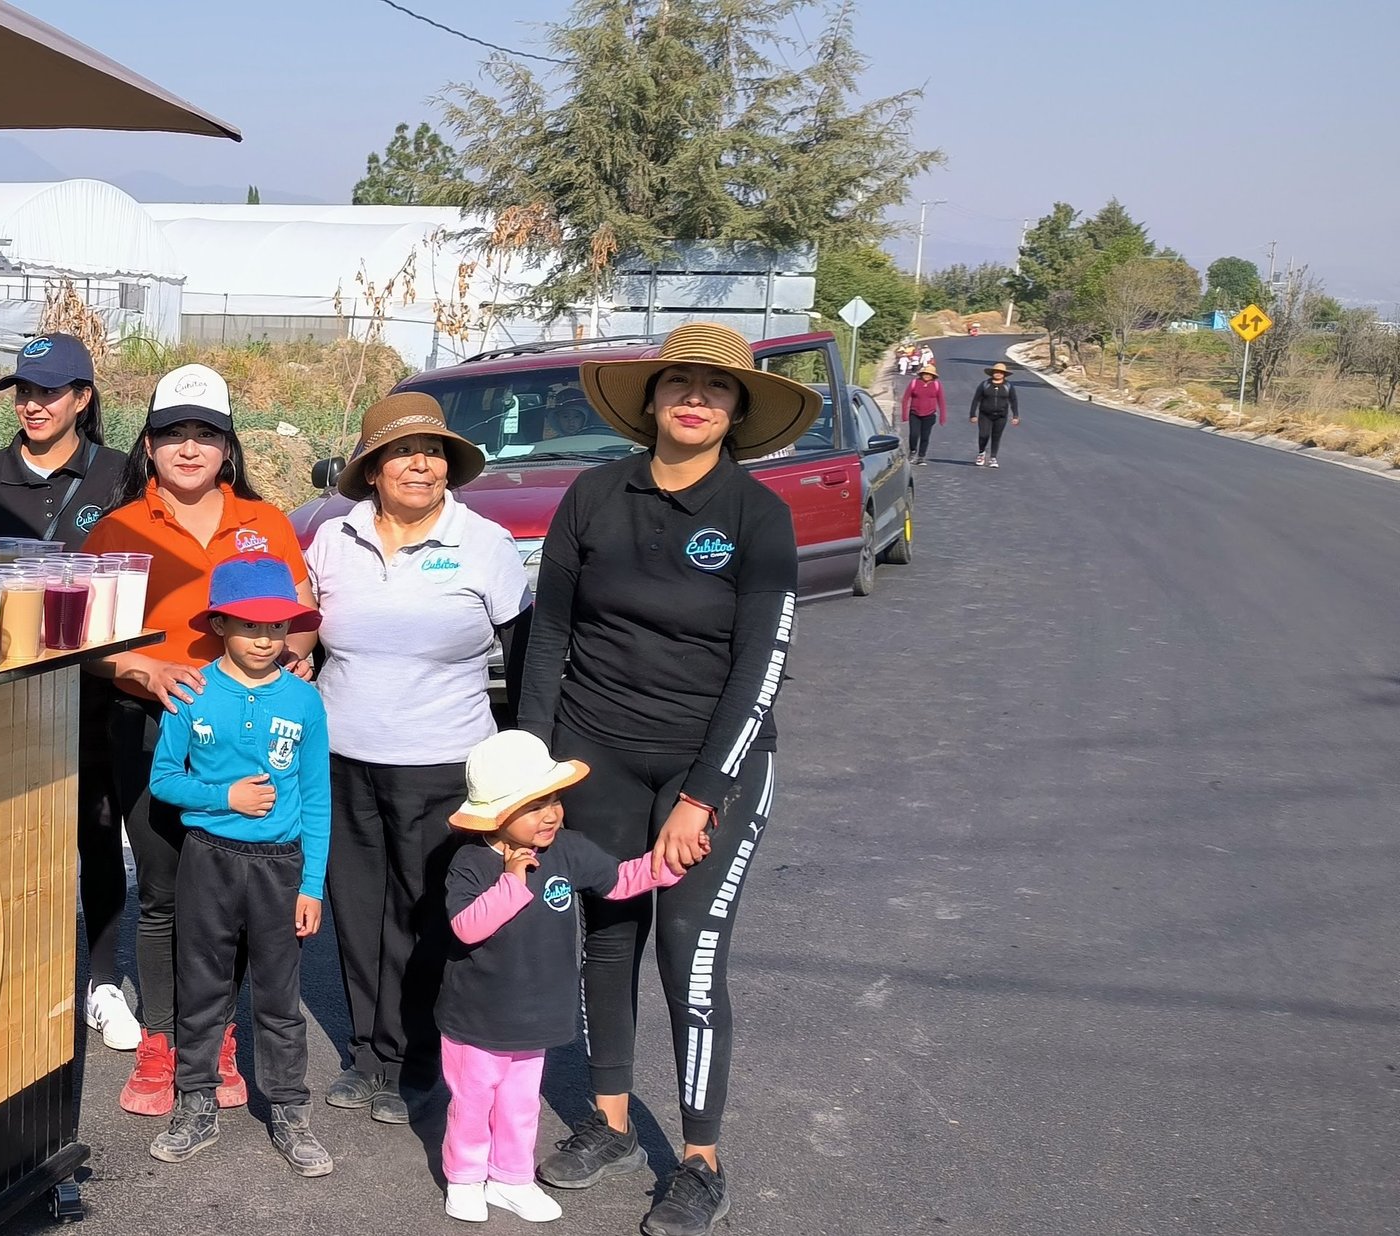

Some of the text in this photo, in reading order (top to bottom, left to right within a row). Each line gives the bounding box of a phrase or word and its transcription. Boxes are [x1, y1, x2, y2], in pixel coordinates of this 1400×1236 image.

[174, 381, 208, 393] Cubitos
[76, 510, 100, 527] Cubit
[686, 538, 735, 554] Cubitos
[421, 558, 460, 571] Cubitos
[756, 649, 786, 707] PUMA
[708, 839, 755, 919] PUMA
[688, 930, 720, 1006] PUMA
